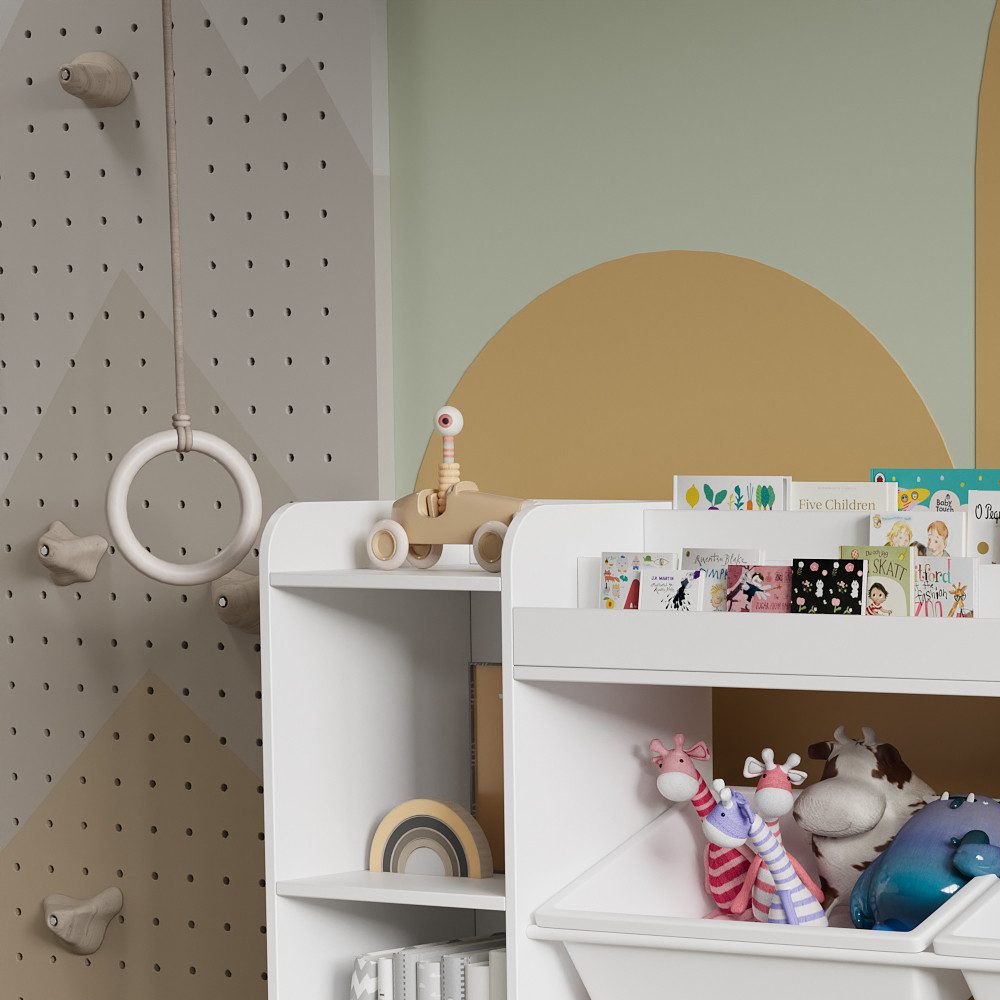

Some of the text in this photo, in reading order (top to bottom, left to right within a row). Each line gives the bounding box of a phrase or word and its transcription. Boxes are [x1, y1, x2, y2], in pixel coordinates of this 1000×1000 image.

[799, 498, 876, 511] Five Children
[936, 499, 953, 507] Baby
[873, 560, 908, 581] SKATT
